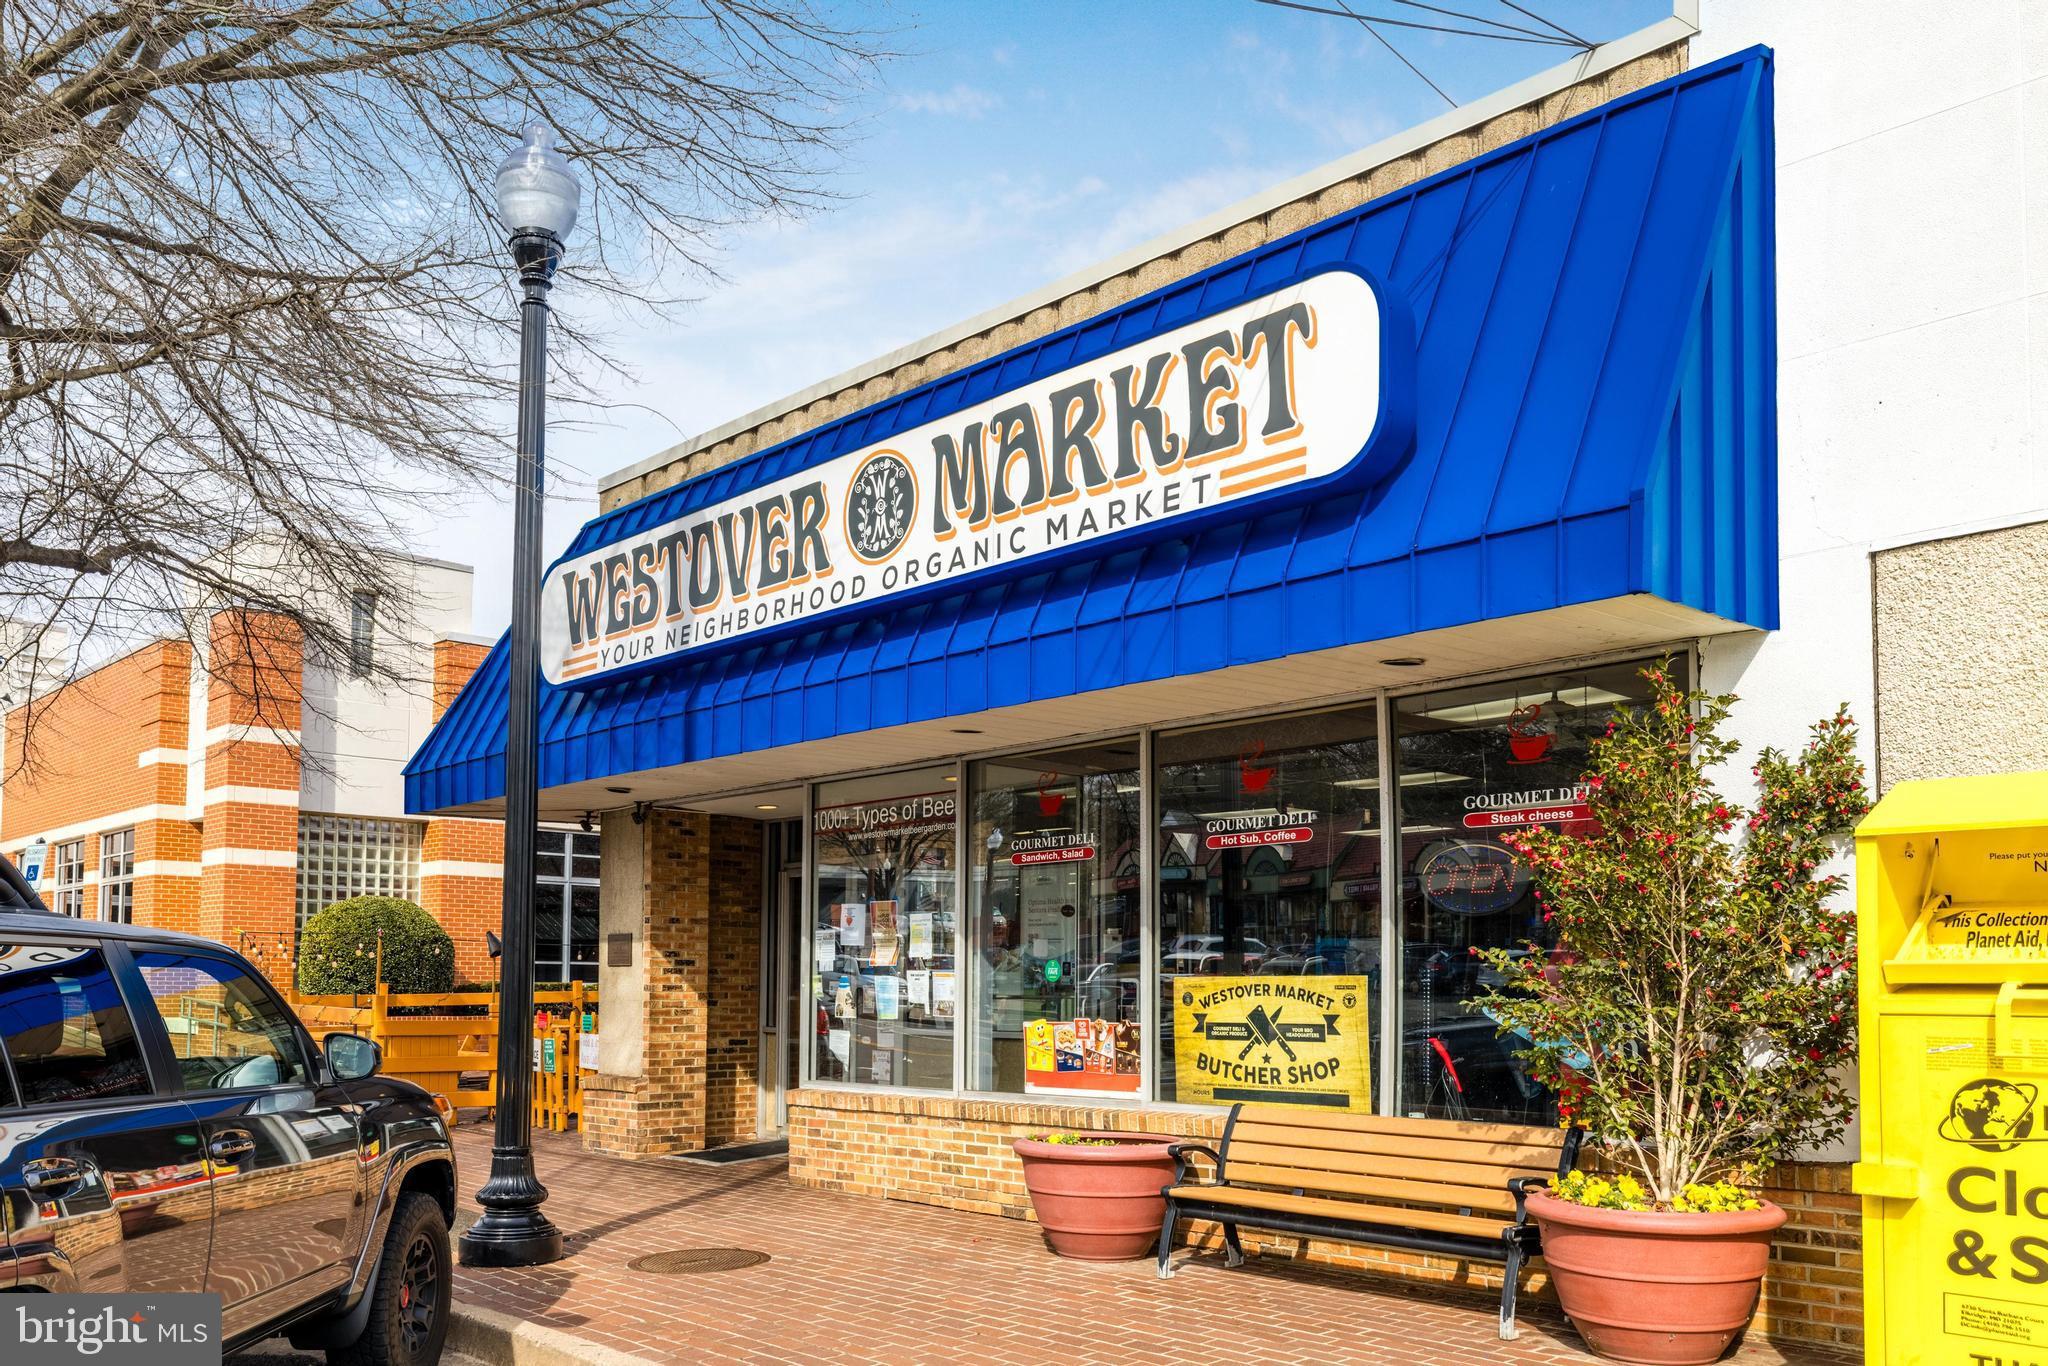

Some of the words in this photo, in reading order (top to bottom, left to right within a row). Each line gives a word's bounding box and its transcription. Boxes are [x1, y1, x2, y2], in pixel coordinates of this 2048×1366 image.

[562, 480, 834, 650] WESTOVER
[932, 302, 1314, 537] MARKET
[600, 635, 654, 668] YOUR
[665, 574, 867, 650] NEIGHBORHOOD
[882, 526, 1026, 590] ORGANIC
[1046, 473, 1212, 545] MARKET
[1463, 788, 1554, 810] GOURMET
[814, 808, 850, 831] 1000+
[853, 805, 897, 831] Types
[902, 798, 918, 821] of
[922, 797, 956, 818] Bee
[1206, 815, 1276, 833] GOURMET
[1279, 811, 1313, 826] DELI
[1491, 813, 1525, 824] Steak
[1528, 810, 1574, 822] cheese
[848, 822, 956, 841] www.westovermarketbeergarden.co
[1011, 835, 1065, 851] GOURMET
[1068, 832, 1095, 846] DELI
[1220, 836, 1238, 846] Hot
[1240, 834, 1262, 844] Sub,
[1264, 831, 1297, 842] Coffee
[1021, 851, 1060, 863] Sandwich,
[1062, 849, 1084, 859] Salad
[1990, 852, 2015, 860] Please
[2017, 853, 2030, 861] put
[1427, 863, 1518, 896] OPEN
[1966, 931, 2011, 949] Planet
[2013, 930, 2042, 951] Aid,
[1198, 984, 1271, 1010] WESTOVER
[1275, 984, 1335, 1011] MARKET
[1196, 1051, 1282, 1085] BUTCHER
[1288, 1057, 1340, 1086] SHOP
[1946, 1228, 1997, 1280] &
